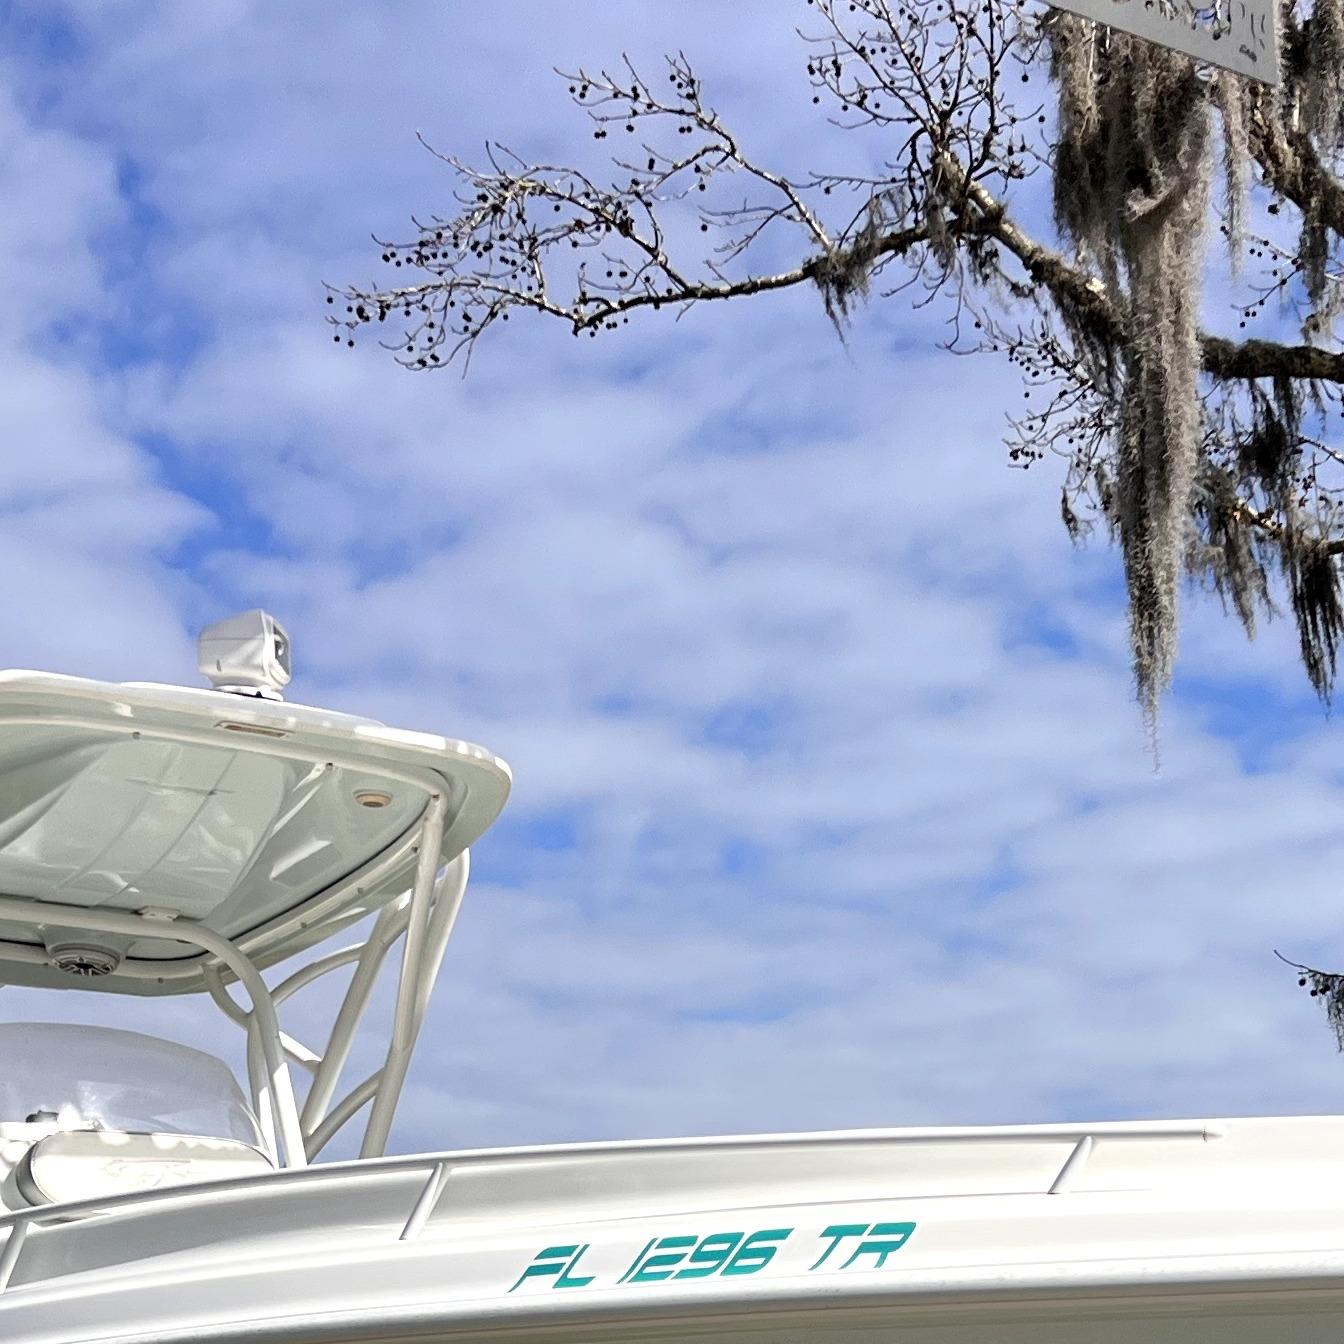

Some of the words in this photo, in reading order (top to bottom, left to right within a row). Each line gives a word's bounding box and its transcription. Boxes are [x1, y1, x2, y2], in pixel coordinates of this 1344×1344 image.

[506, 1243, 596, 1293] FL
[615, 1227, 795, 1285] 1296
[808, 1221, 917, 1271] TR
